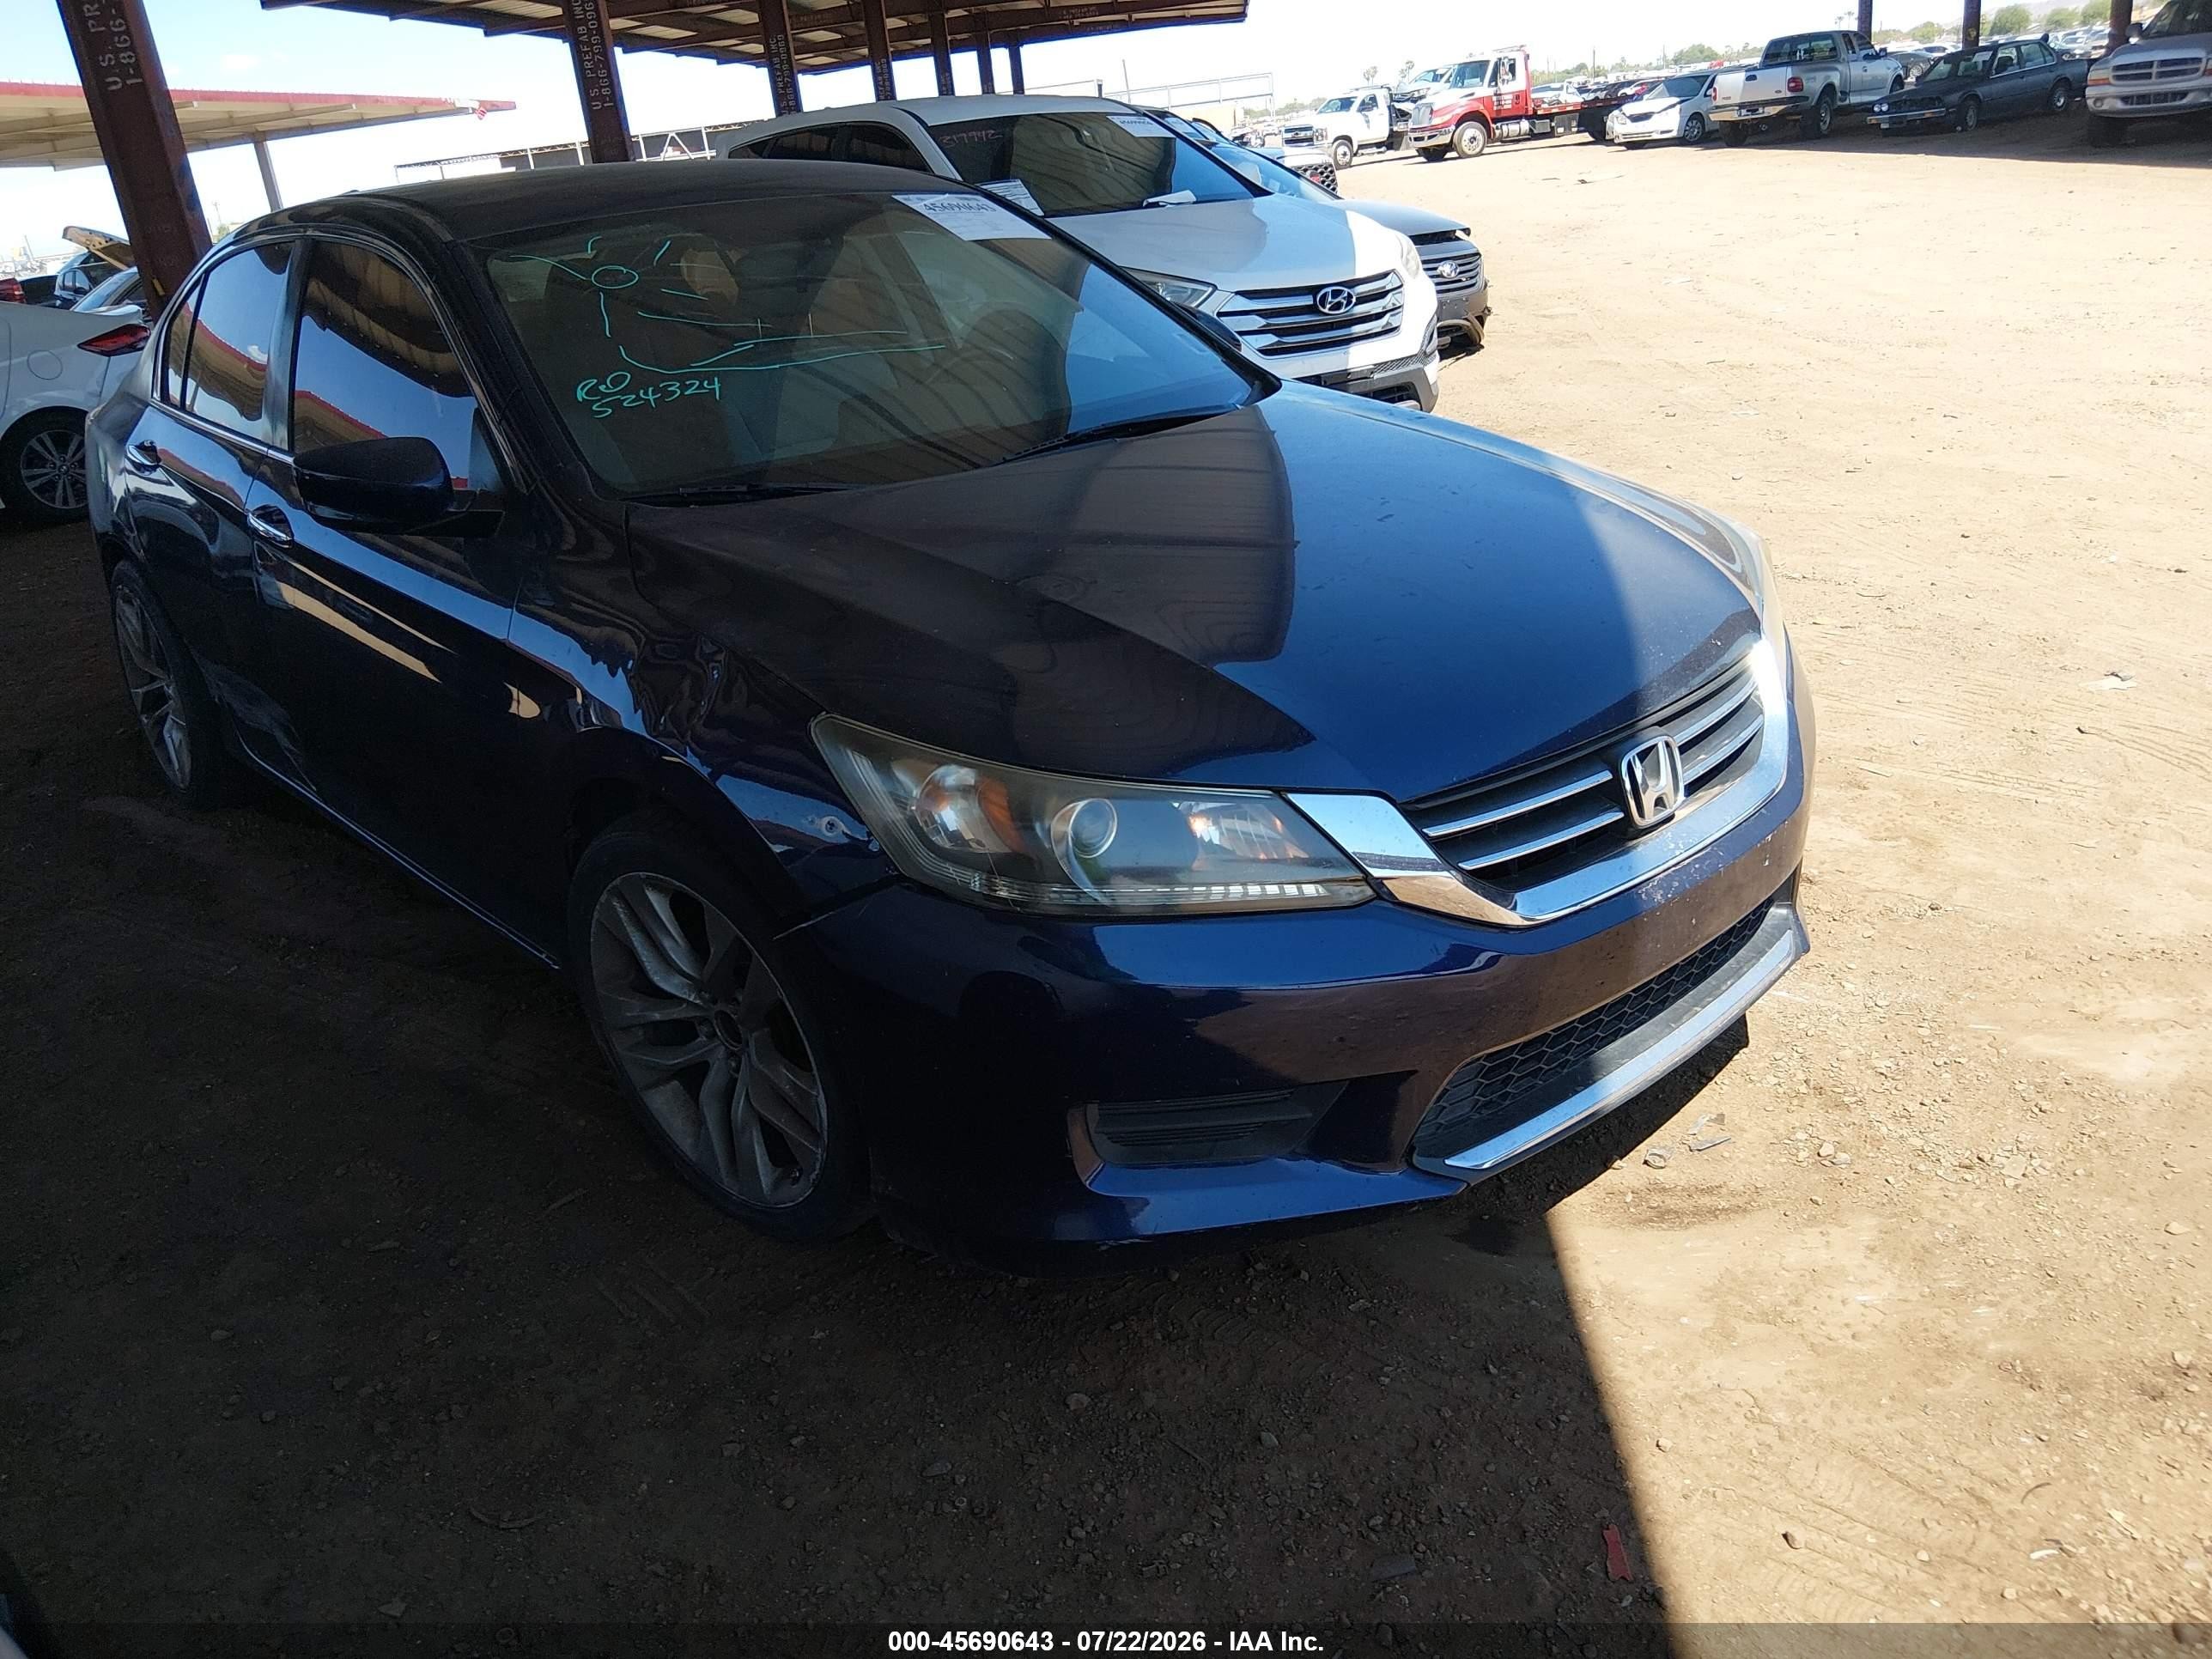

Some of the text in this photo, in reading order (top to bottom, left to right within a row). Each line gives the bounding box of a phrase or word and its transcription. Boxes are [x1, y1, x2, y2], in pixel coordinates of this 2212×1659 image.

[83, 0, 106, 33] PR
[577, 26, 596, 77] PREFAB
[585, 0, 614, 107] 1-866-799-096
